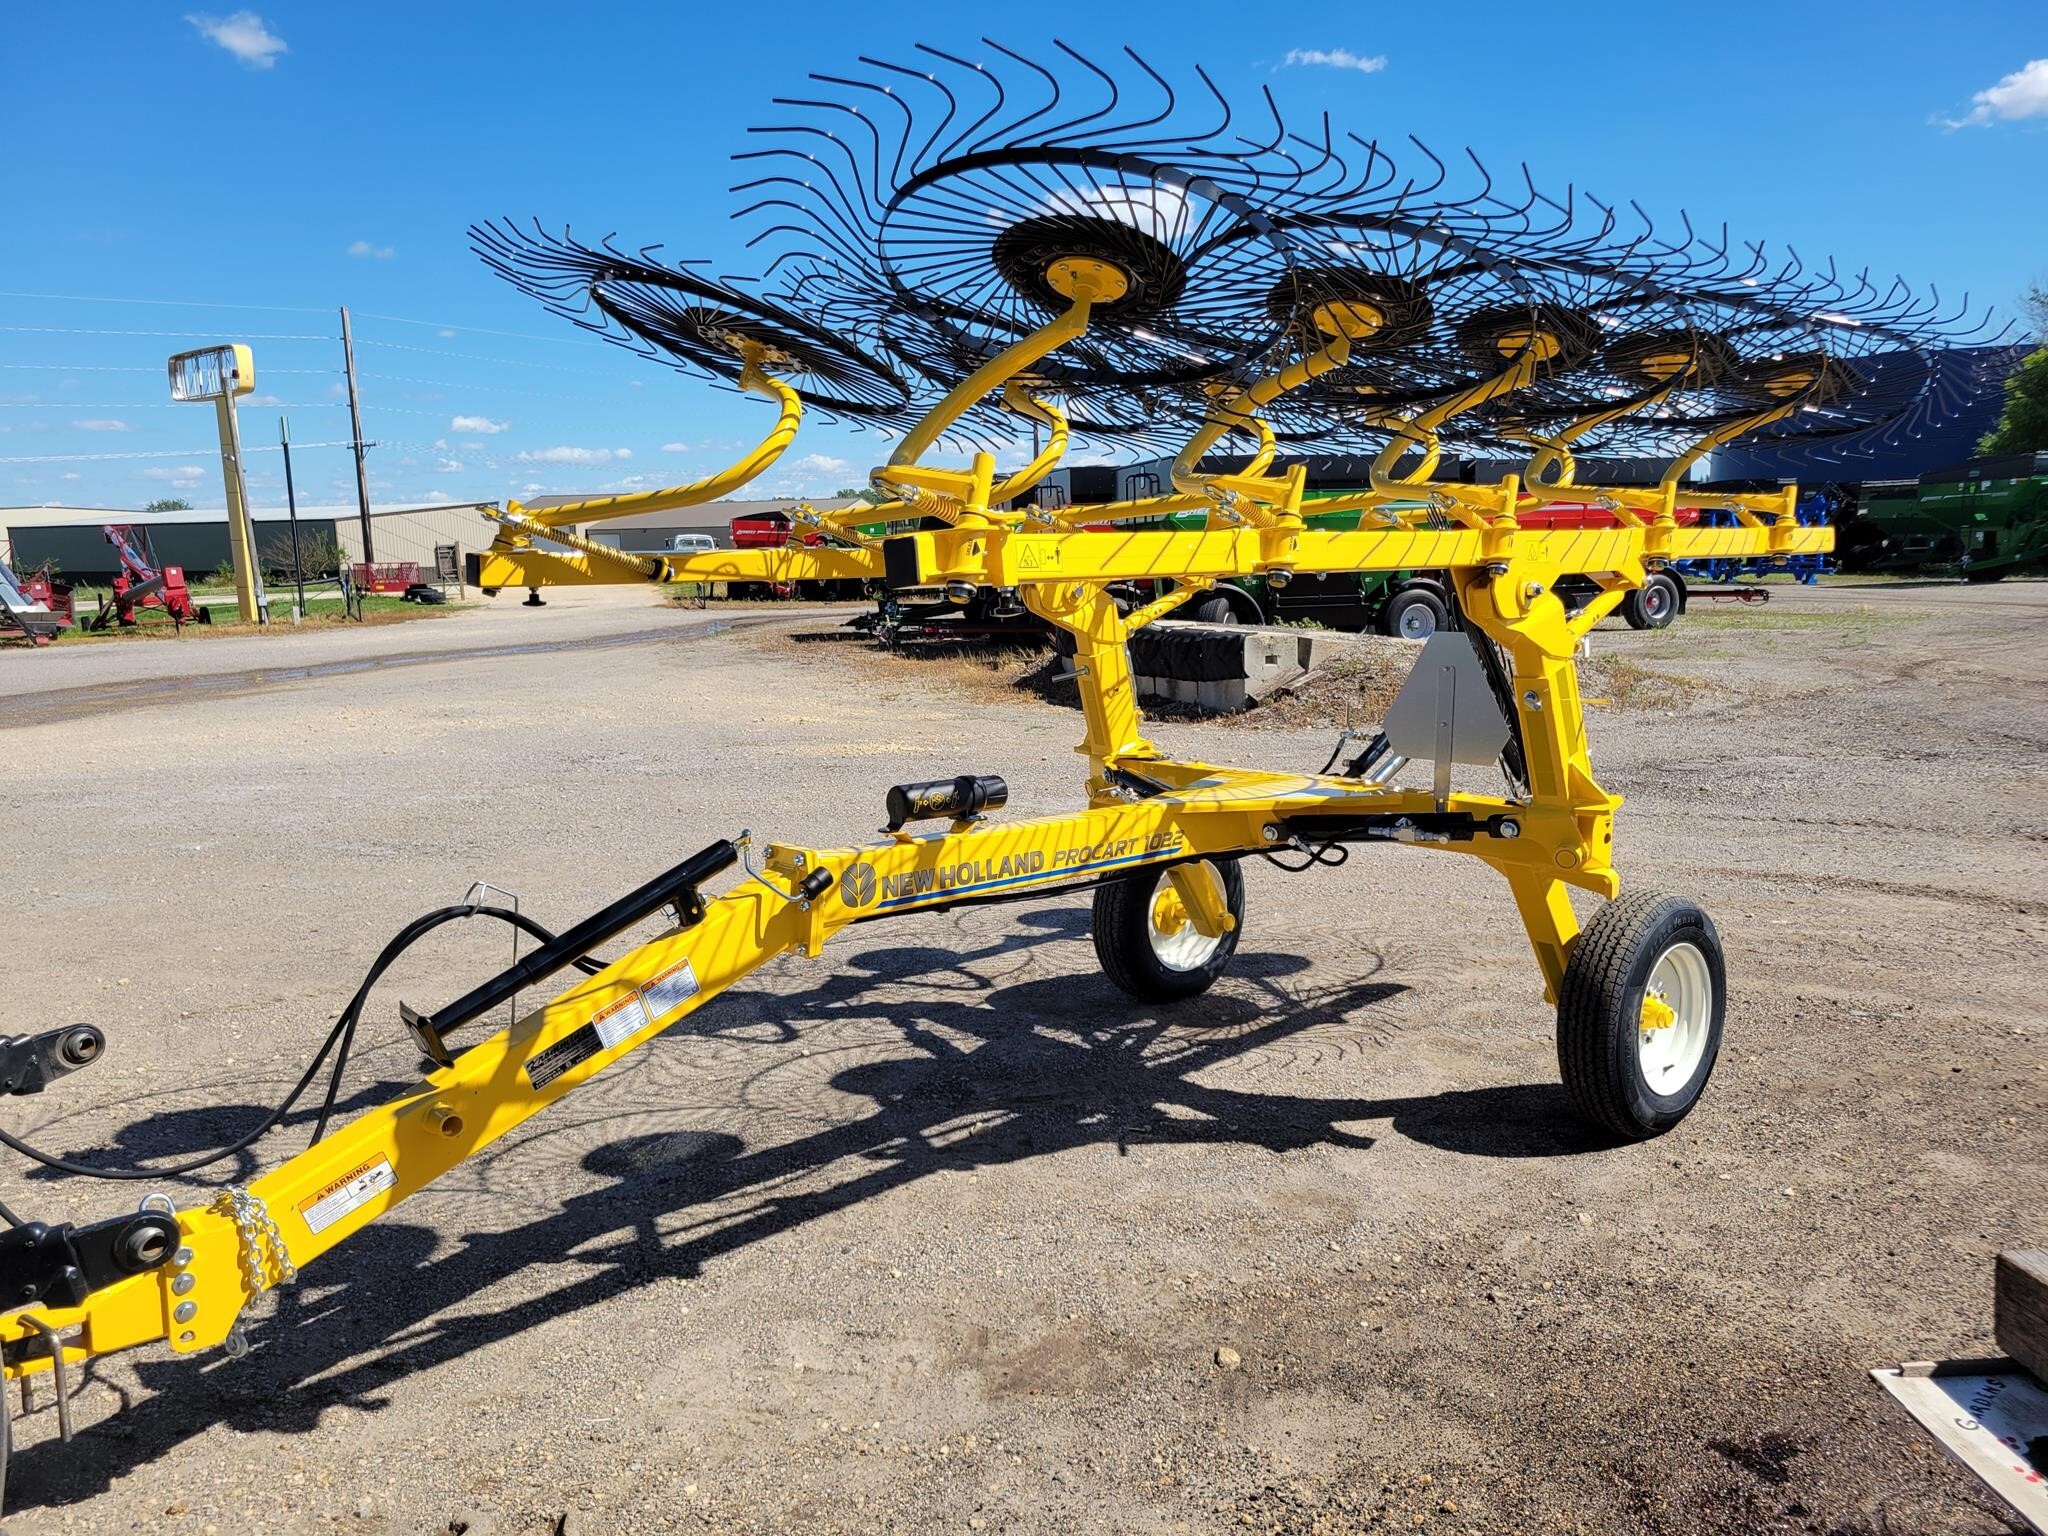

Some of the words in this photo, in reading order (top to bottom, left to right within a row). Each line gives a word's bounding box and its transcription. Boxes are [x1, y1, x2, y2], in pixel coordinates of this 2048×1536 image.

[882, 868, 936, 899] NEW
[939, 850, 1045, 889] HOLLAND
[1052, 837, 1139, 868] PROCART
[1144, 829, 1185, 852] 1022
[605, 995, 634, 1016] WARNING
[324, 1163, 370, 1194] WARNING
